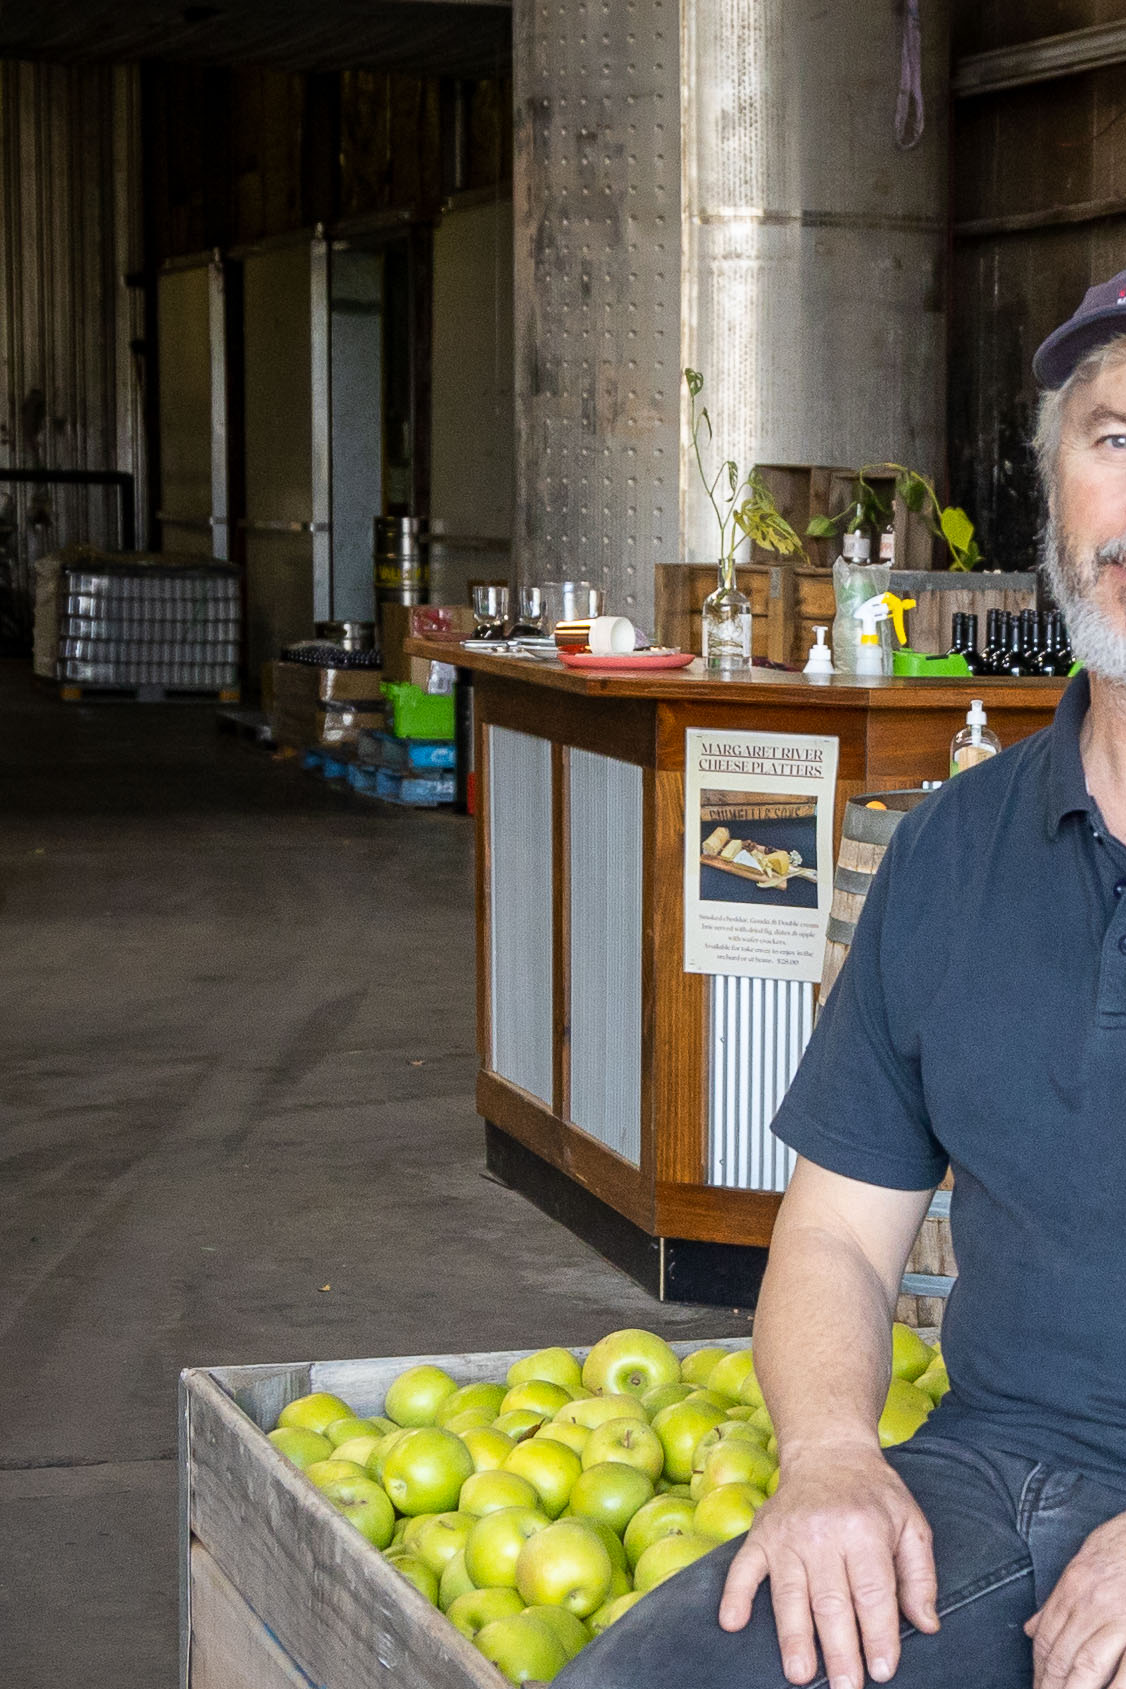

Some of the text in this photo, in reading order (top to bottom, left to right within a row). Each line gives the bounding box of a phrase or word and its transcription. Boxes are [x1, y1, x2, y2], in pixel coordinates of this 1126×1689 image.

[702, 742, 823, 761] MARGARET RIVER
[699, 759, 822, 776] CHEESE PLATTERS
